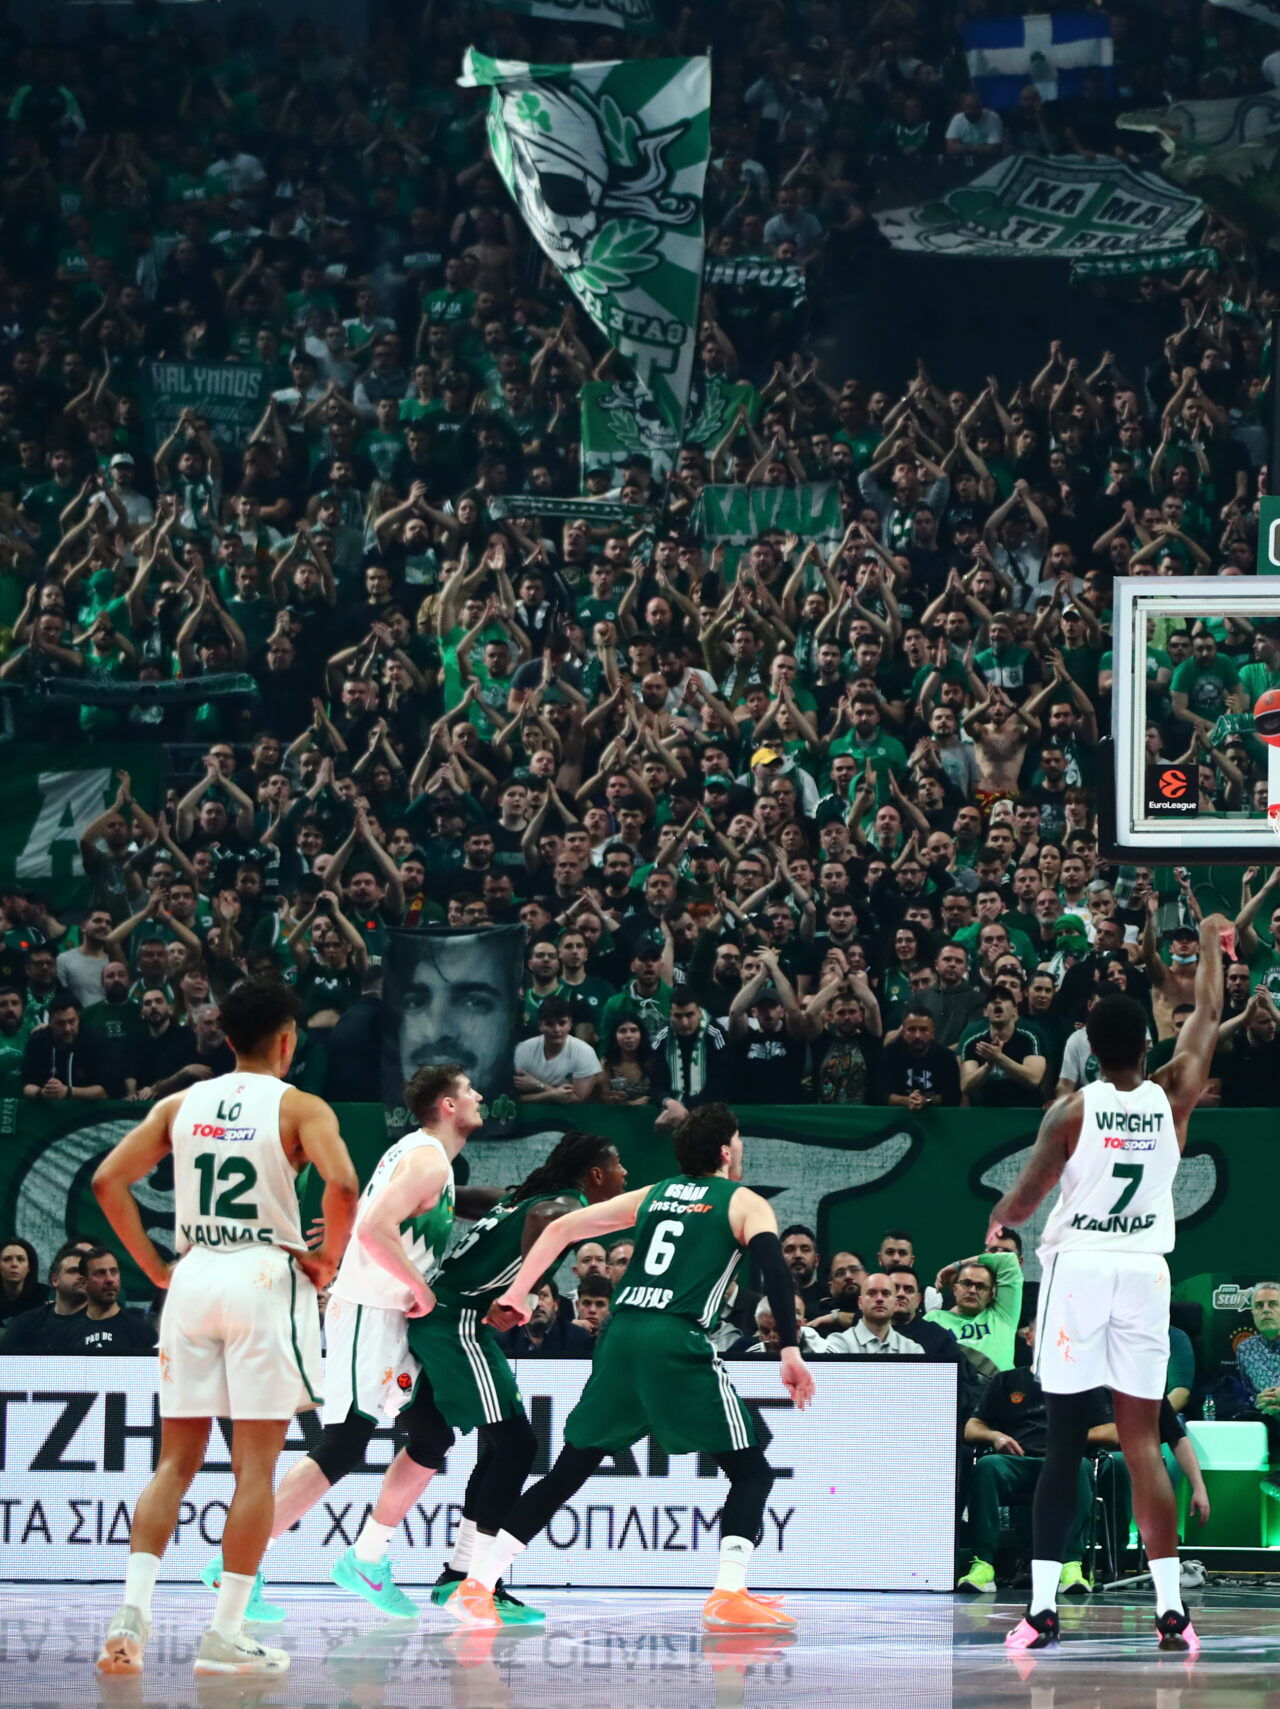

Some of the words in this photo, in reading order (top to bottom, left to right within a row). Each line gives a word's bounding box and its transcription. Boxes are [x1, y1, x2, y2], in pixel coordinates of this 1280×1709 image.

[1148, 801, 1197, 811] EuroLeague
[216, 1099, 242, 1122] LO
[194, 1152, 259, 1220] 12
[1108, 1162, 1145, 1215] 7
[181, 1223, 274, 1246] KAUNAS
[1071, 1213, 1157, 1234] KAUNAS
[643, 1219, 685, 1277] 6
[546, 1504, 796, 1552] ΟΠΛΙΣΜΥ
